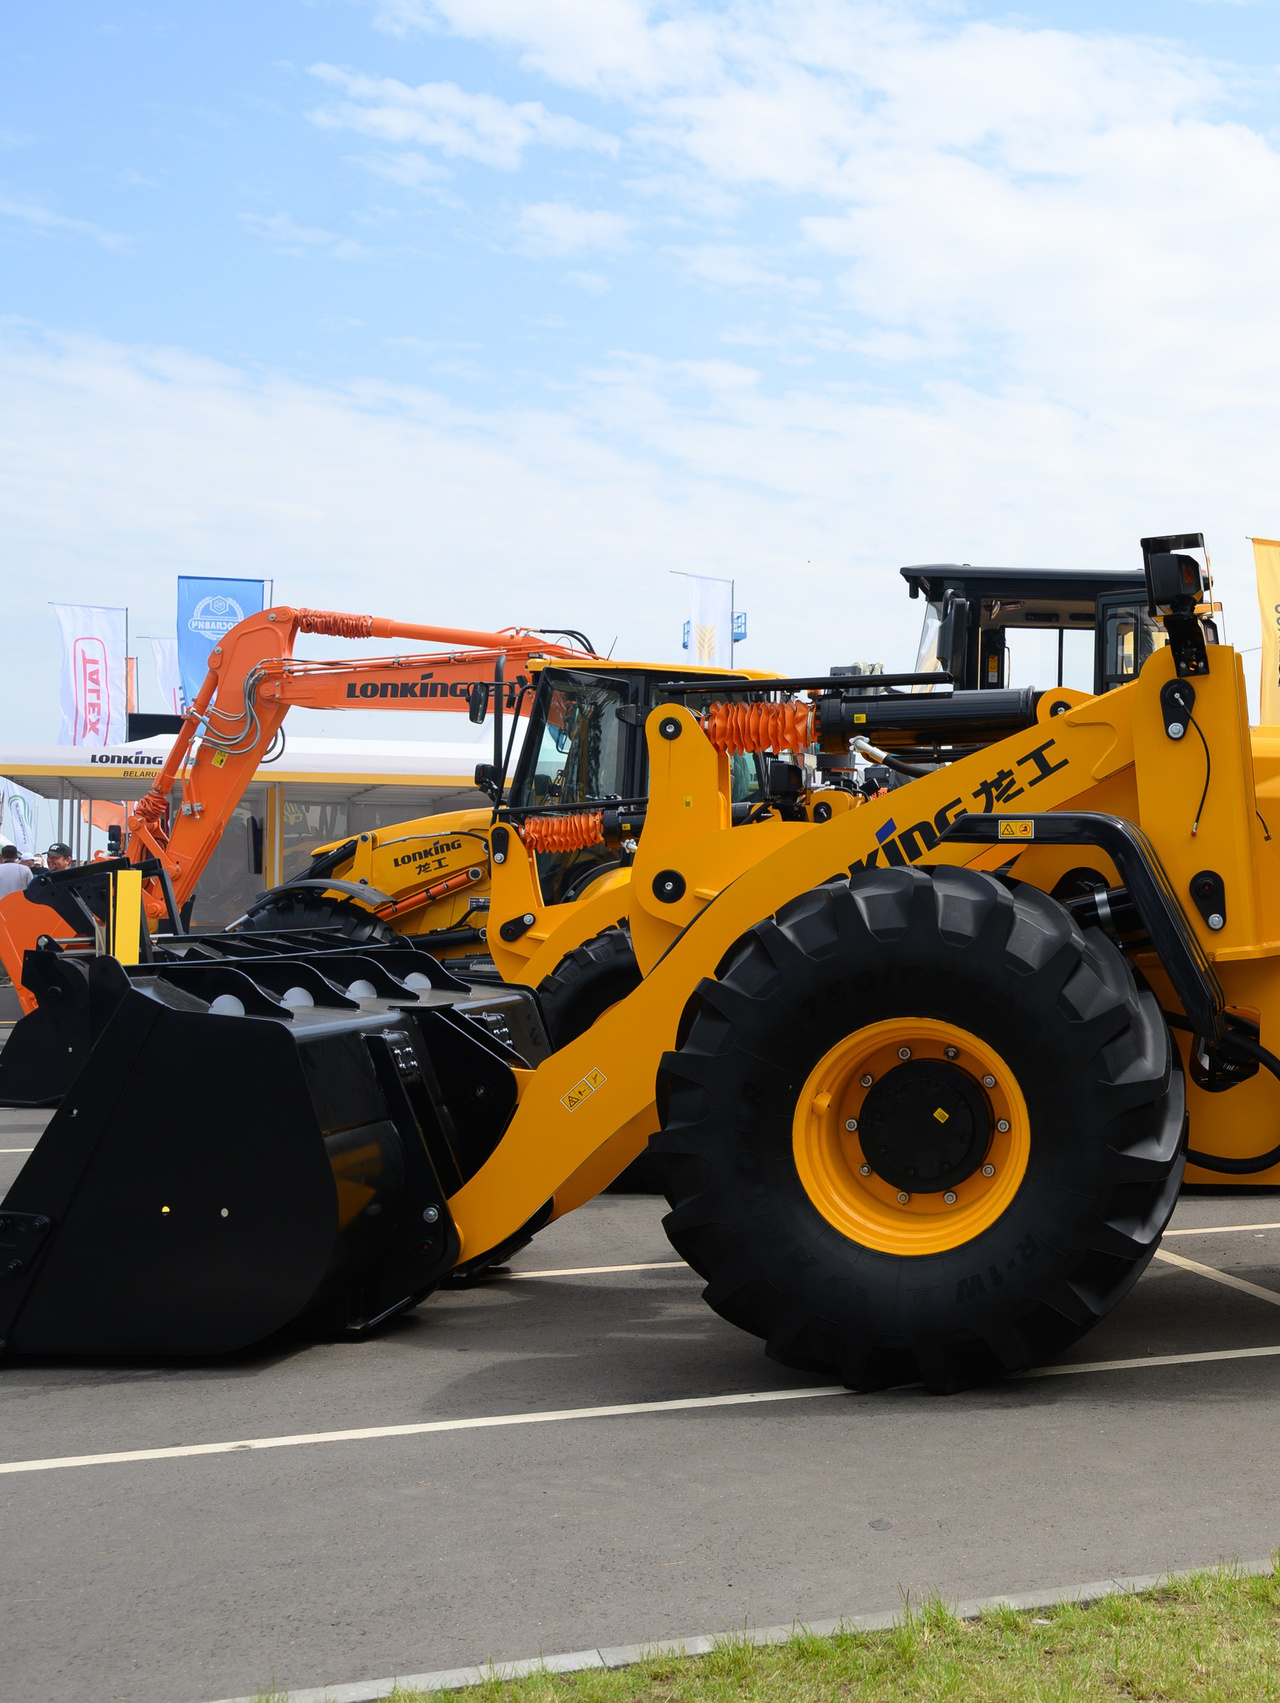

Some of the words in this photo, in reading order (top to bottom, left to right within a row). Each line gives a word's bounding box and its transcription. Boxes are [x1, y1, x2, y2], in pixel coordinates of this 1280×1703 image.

[347, 672, 469, 699] LONKING
[91, 750, 163, 765] LONKING
[123, 770, 157, 778] BELARU
[828, 797, 968, 881] KING
[972, 738, 1070, 814] 龙工
[393, 839, 462, 868] LONKING
[415, 857, 449, 875] 龙工
